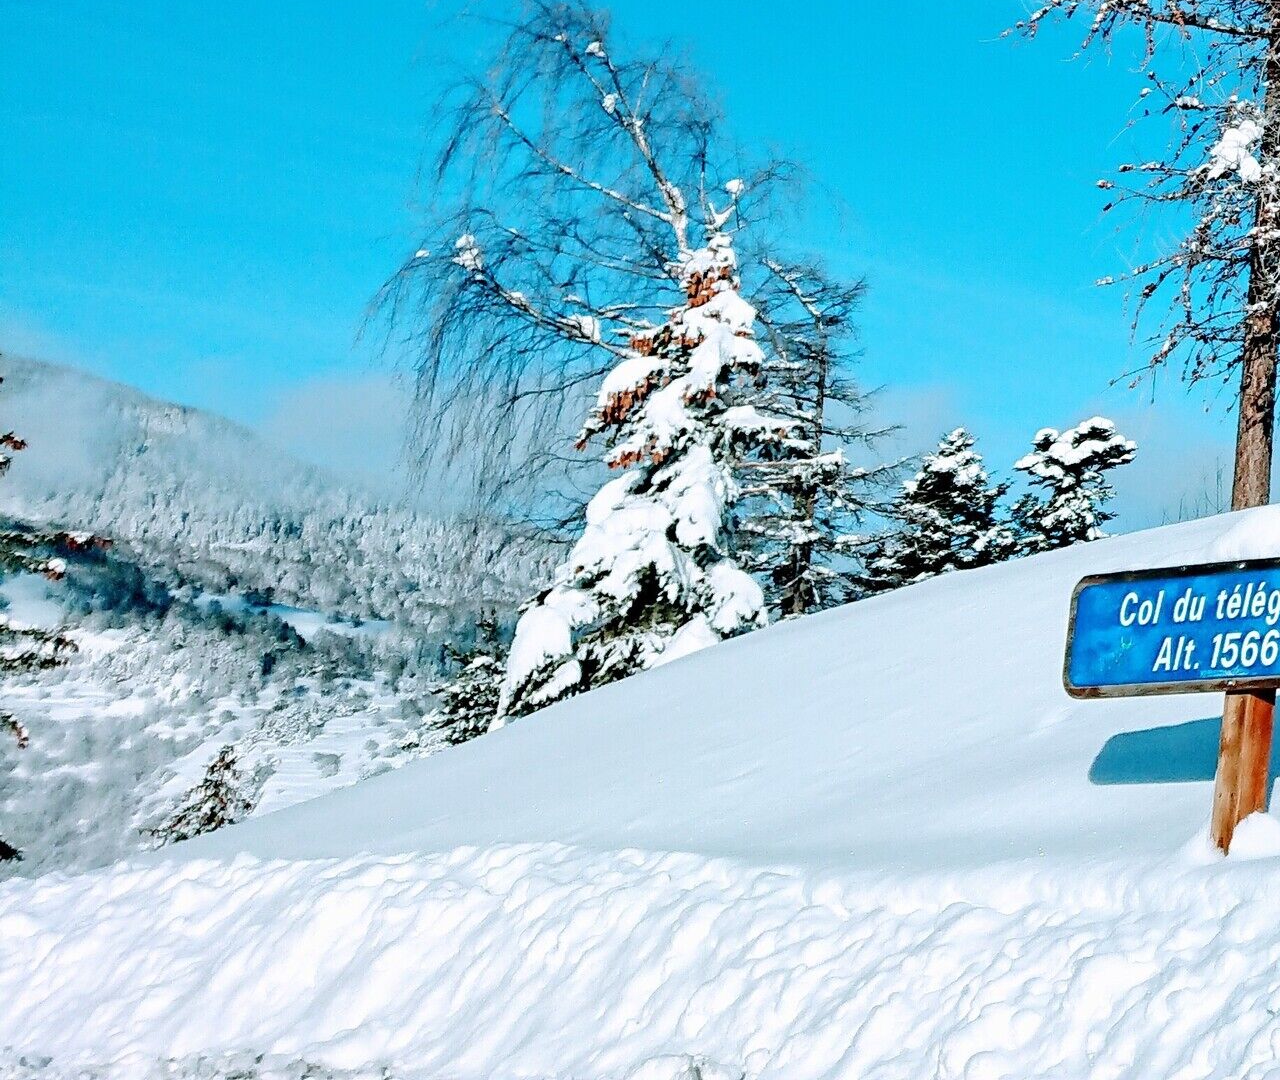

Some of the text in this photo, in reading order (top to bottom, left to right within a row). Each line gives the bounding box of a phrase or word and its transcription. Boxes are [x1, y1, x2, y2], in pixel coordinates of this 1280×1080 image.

[1119, 591, 1164, 626] Col
[1173, 588, 1206, 623] du
[1152, 636, 1200, 672] Alt.
[1210, 629, 1280, 669] 1566
